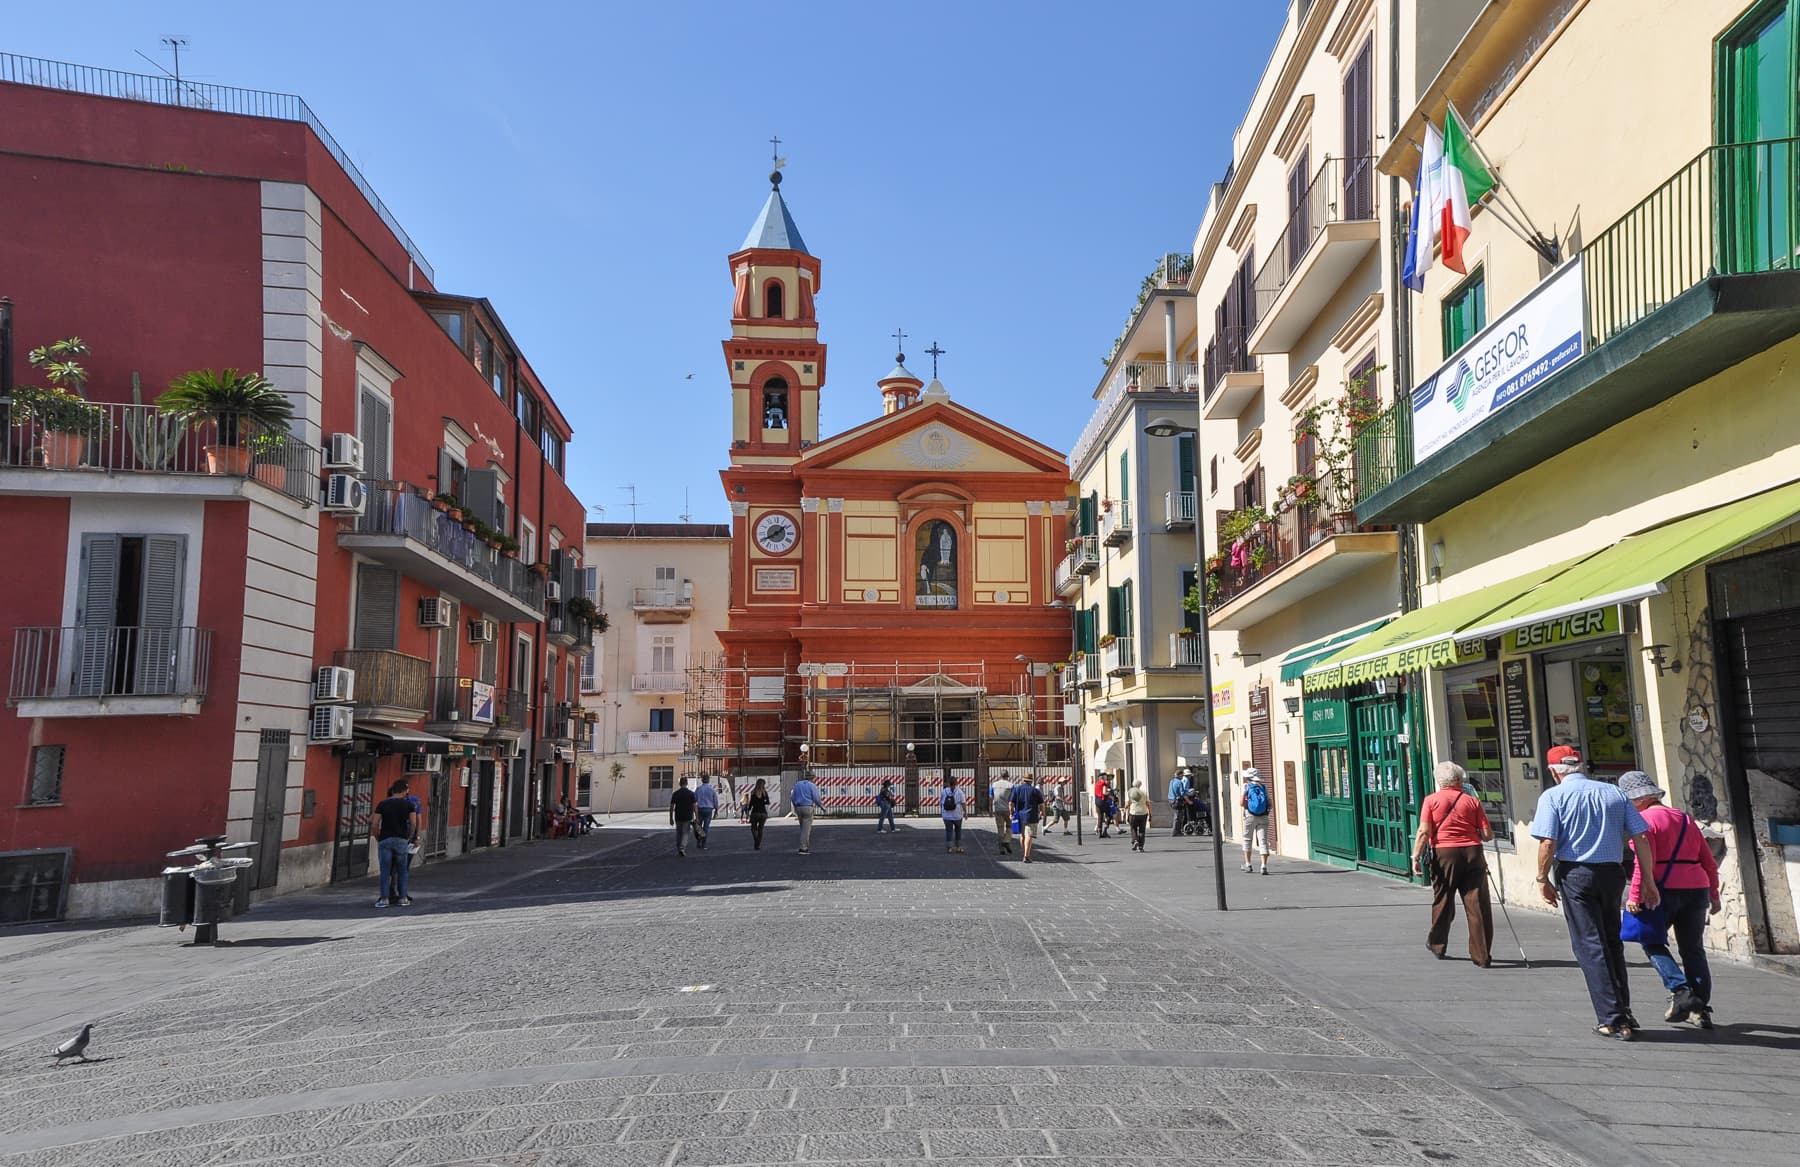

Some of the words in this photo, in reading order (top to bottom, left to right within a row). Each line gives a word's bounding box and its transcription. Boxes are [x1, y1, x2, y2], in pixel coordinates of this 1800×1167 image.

[1475, 324, 1528, 382] GESFOR
[1506, 350, 1530, 372] LAVORO
[1506, 380, 1519, 396] 081
[1519, 359, 1549, 387] 8769492
[1516, 609, 1605, 648] BETTER
[1306, 671, 1340, 688] BETTER
[1347, 656, 1389, 679] BETTER
[1398, 640, 1450, 668] BETTER
[1456, 639, 1482, 657] TER
